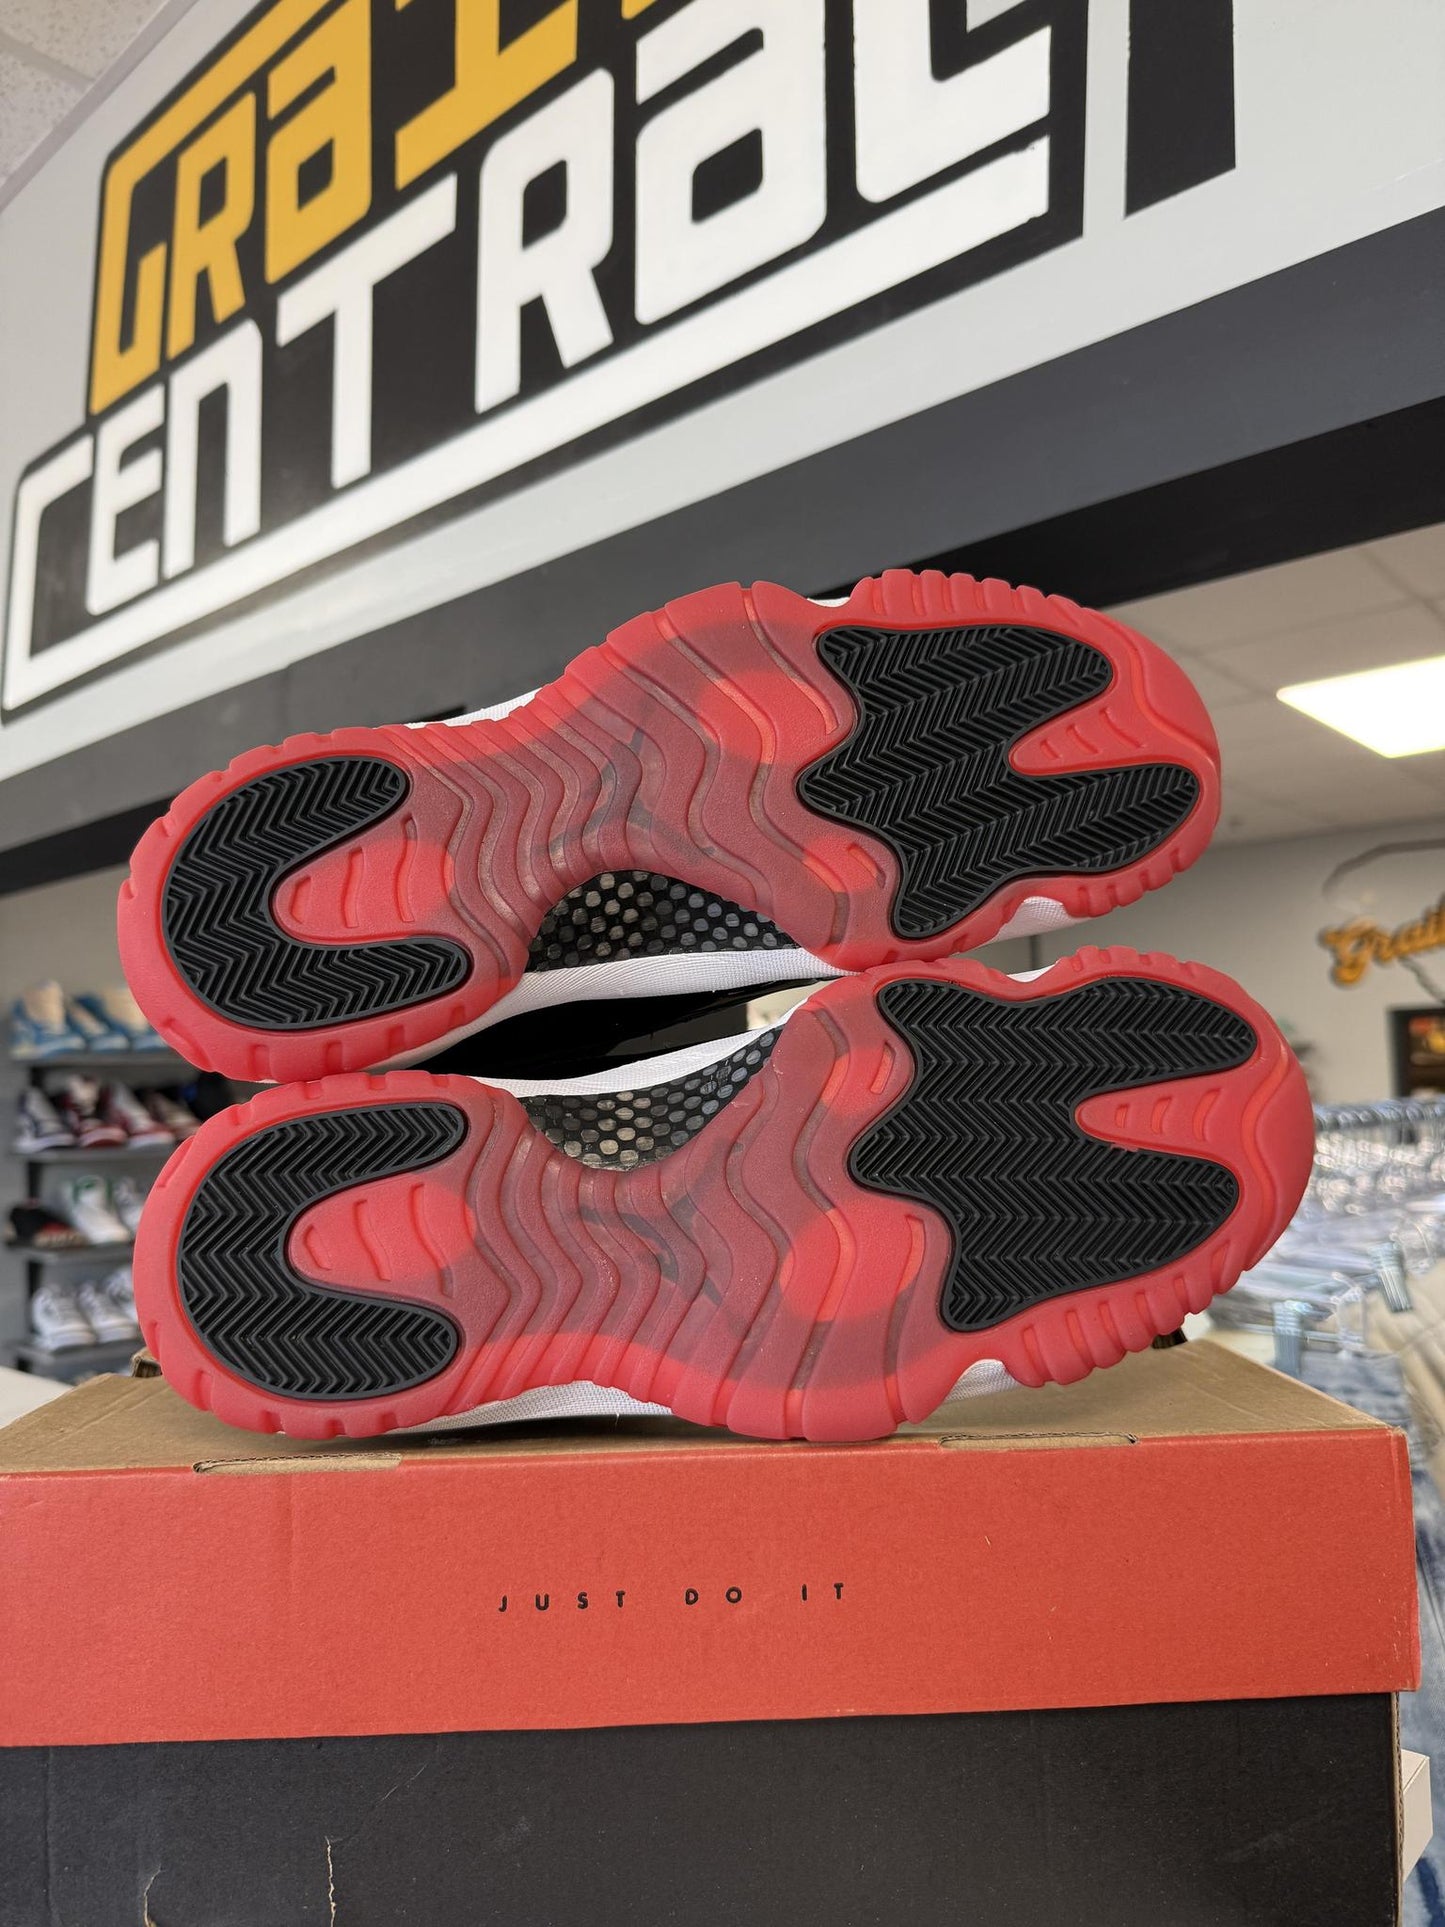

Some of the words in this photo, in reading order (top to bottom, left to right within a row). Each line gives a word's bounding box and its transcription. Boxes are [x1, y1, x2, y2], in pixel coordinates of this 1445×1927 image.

[91, 0, 656, 416] GRAI
[498, 1590, 626, 1613] JUST
[684, 1586, 743, 1606] DO
[801, 1582, 844, 1602] IT
